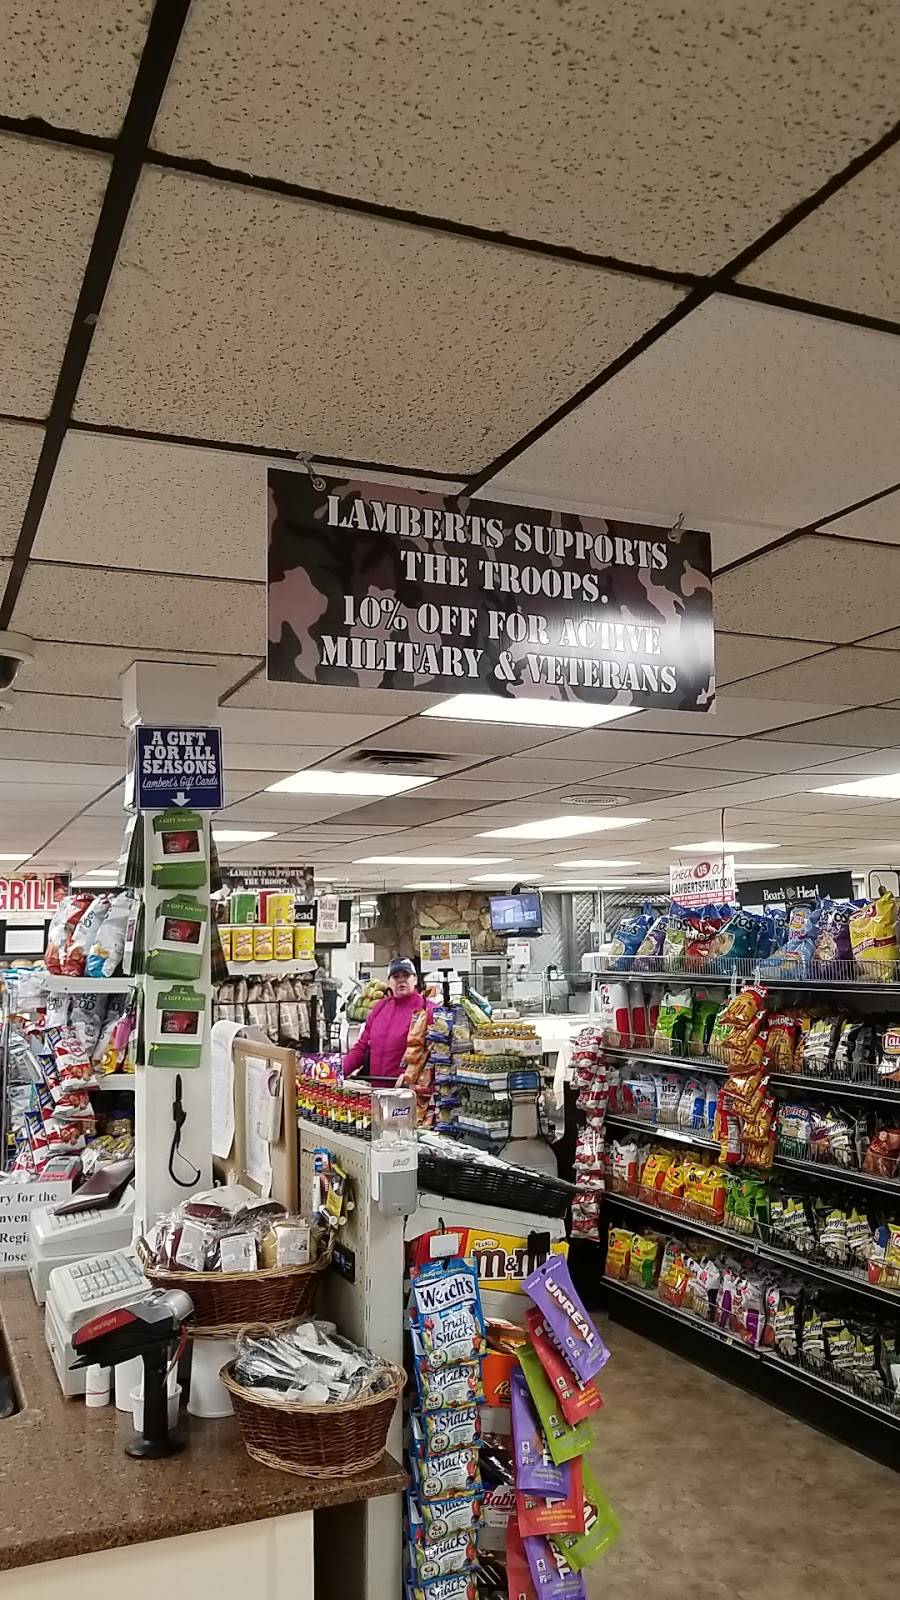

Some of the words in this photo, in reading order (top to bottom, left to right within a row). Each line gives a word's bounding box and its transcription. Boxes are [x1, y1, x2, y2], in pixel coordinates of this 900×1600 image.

[327, 495, 504, 548] LAMBERTS
[514, 522, 668, 570] SUPPORTS
[400, 550, 468, 587] THE
[479, 560, 609, 604] TROOPS.
[343, 595, 407, 631] 10%
[417, 602, 478, 637] OFF
[488, 610, 550, 645] FOR
[558, 618, 662, 655] ACTIVE
[320, 635, 485, 678] MILITARY
[494, 650, 517, 681] &
[527, 653, 677, 694] VETERANS
[151, 731, 163, 745] A
[167, 731, 207, 746] GIFT
[143, 745, 180, 760] FOR
[183, 746, 216, 760] ALL
[142, 760, 217, 775] SEASONS
[142, 776, 178, 789] Lambert's
[180, 776, 195, 791] Gift
[195, 774, 218, 786] Cards
[672, 867, 693, 881] CHECK
[697, 864, 708, 877] US
[0, 879, 58, 911] GRILL
[763, 887, 786, 902] Boar's
[796, 884, 820, 899] Head
[296, 910, 314, 921] ead
[17, 1192, 35, 1203] for
[38, 1191, 57, 1202] the
[442, 1313, 469, 1333] Fruit
[544, 1276, 597, 1349] UNREAL
[435, 1323, 476, 1348] Snacks
[439, 1407, 477, 1432] Snacks
[431, 1450, 469, 1477] Snacks
